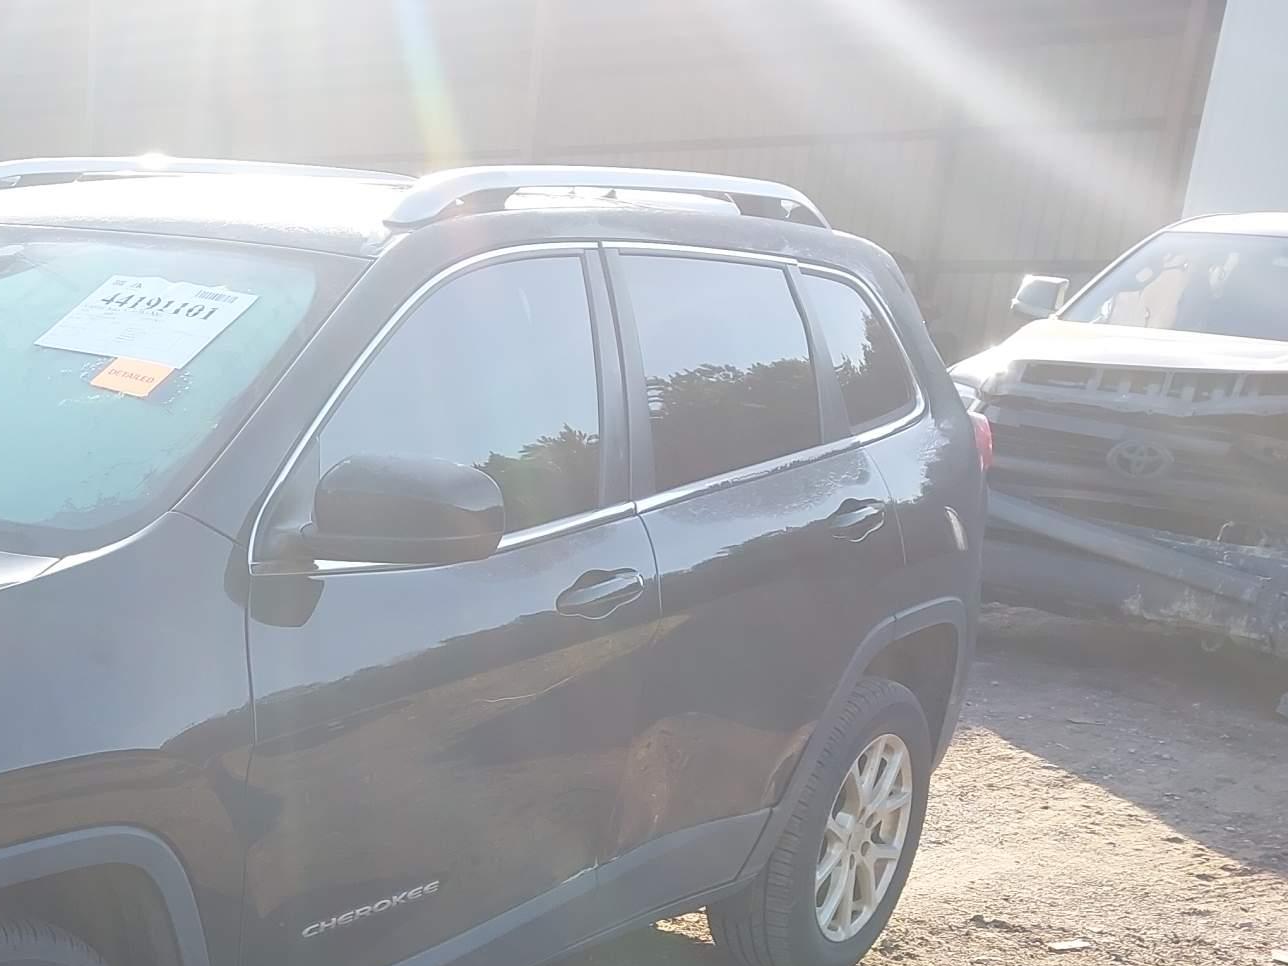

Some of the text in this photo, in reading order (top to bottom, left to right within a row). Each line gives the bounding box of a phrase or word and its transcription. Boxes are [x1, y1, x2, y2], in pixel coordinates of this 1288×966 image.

[101, 292, 218, 320] 44191101
[108, 368, 155, 384] DETAILED
[301, 880, 440, 938] CHEROKEE
